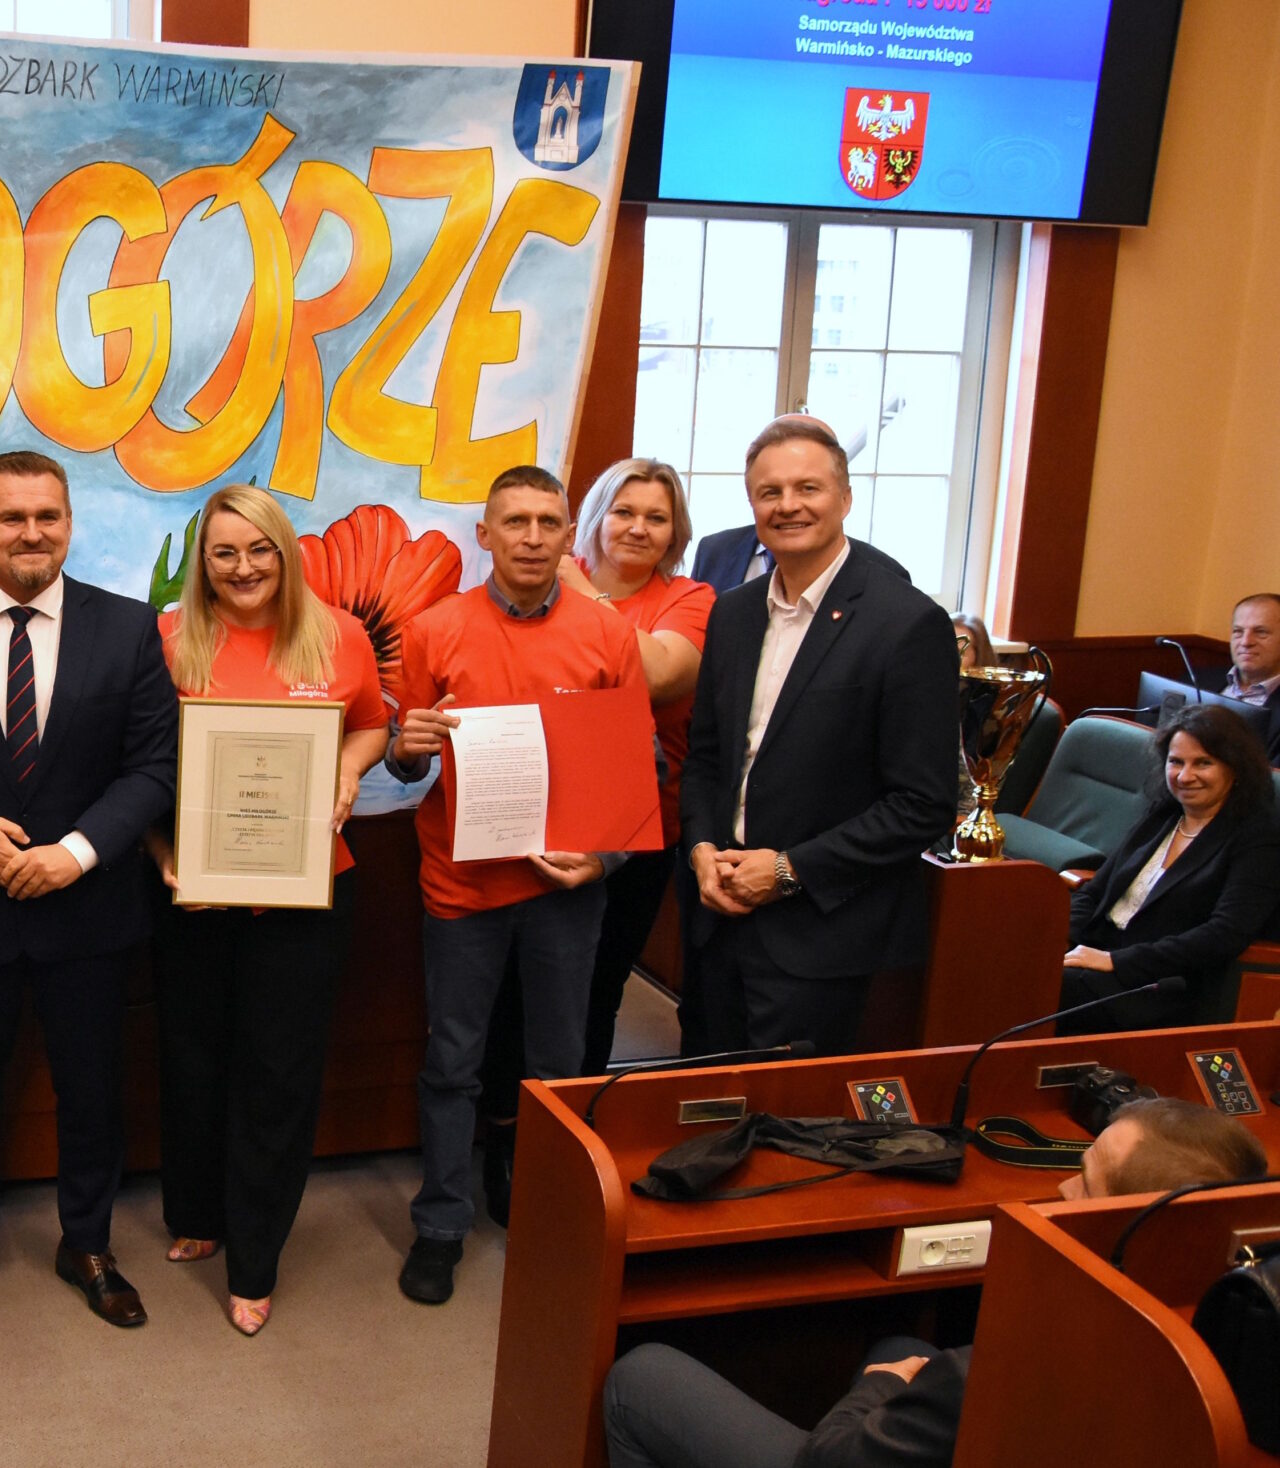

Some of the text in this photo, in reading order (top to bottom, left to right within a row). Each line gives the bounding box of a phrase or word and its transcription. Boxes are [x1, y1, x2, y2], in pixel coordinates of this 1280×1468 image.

[798, 14, 975, 41] Samorządu Województwa
[795, 37, 875, 57] Warmińsko
[886, 44, 973, 67] Mazurskiego
[114, 63, 286, 109] WARMIŃSKI
